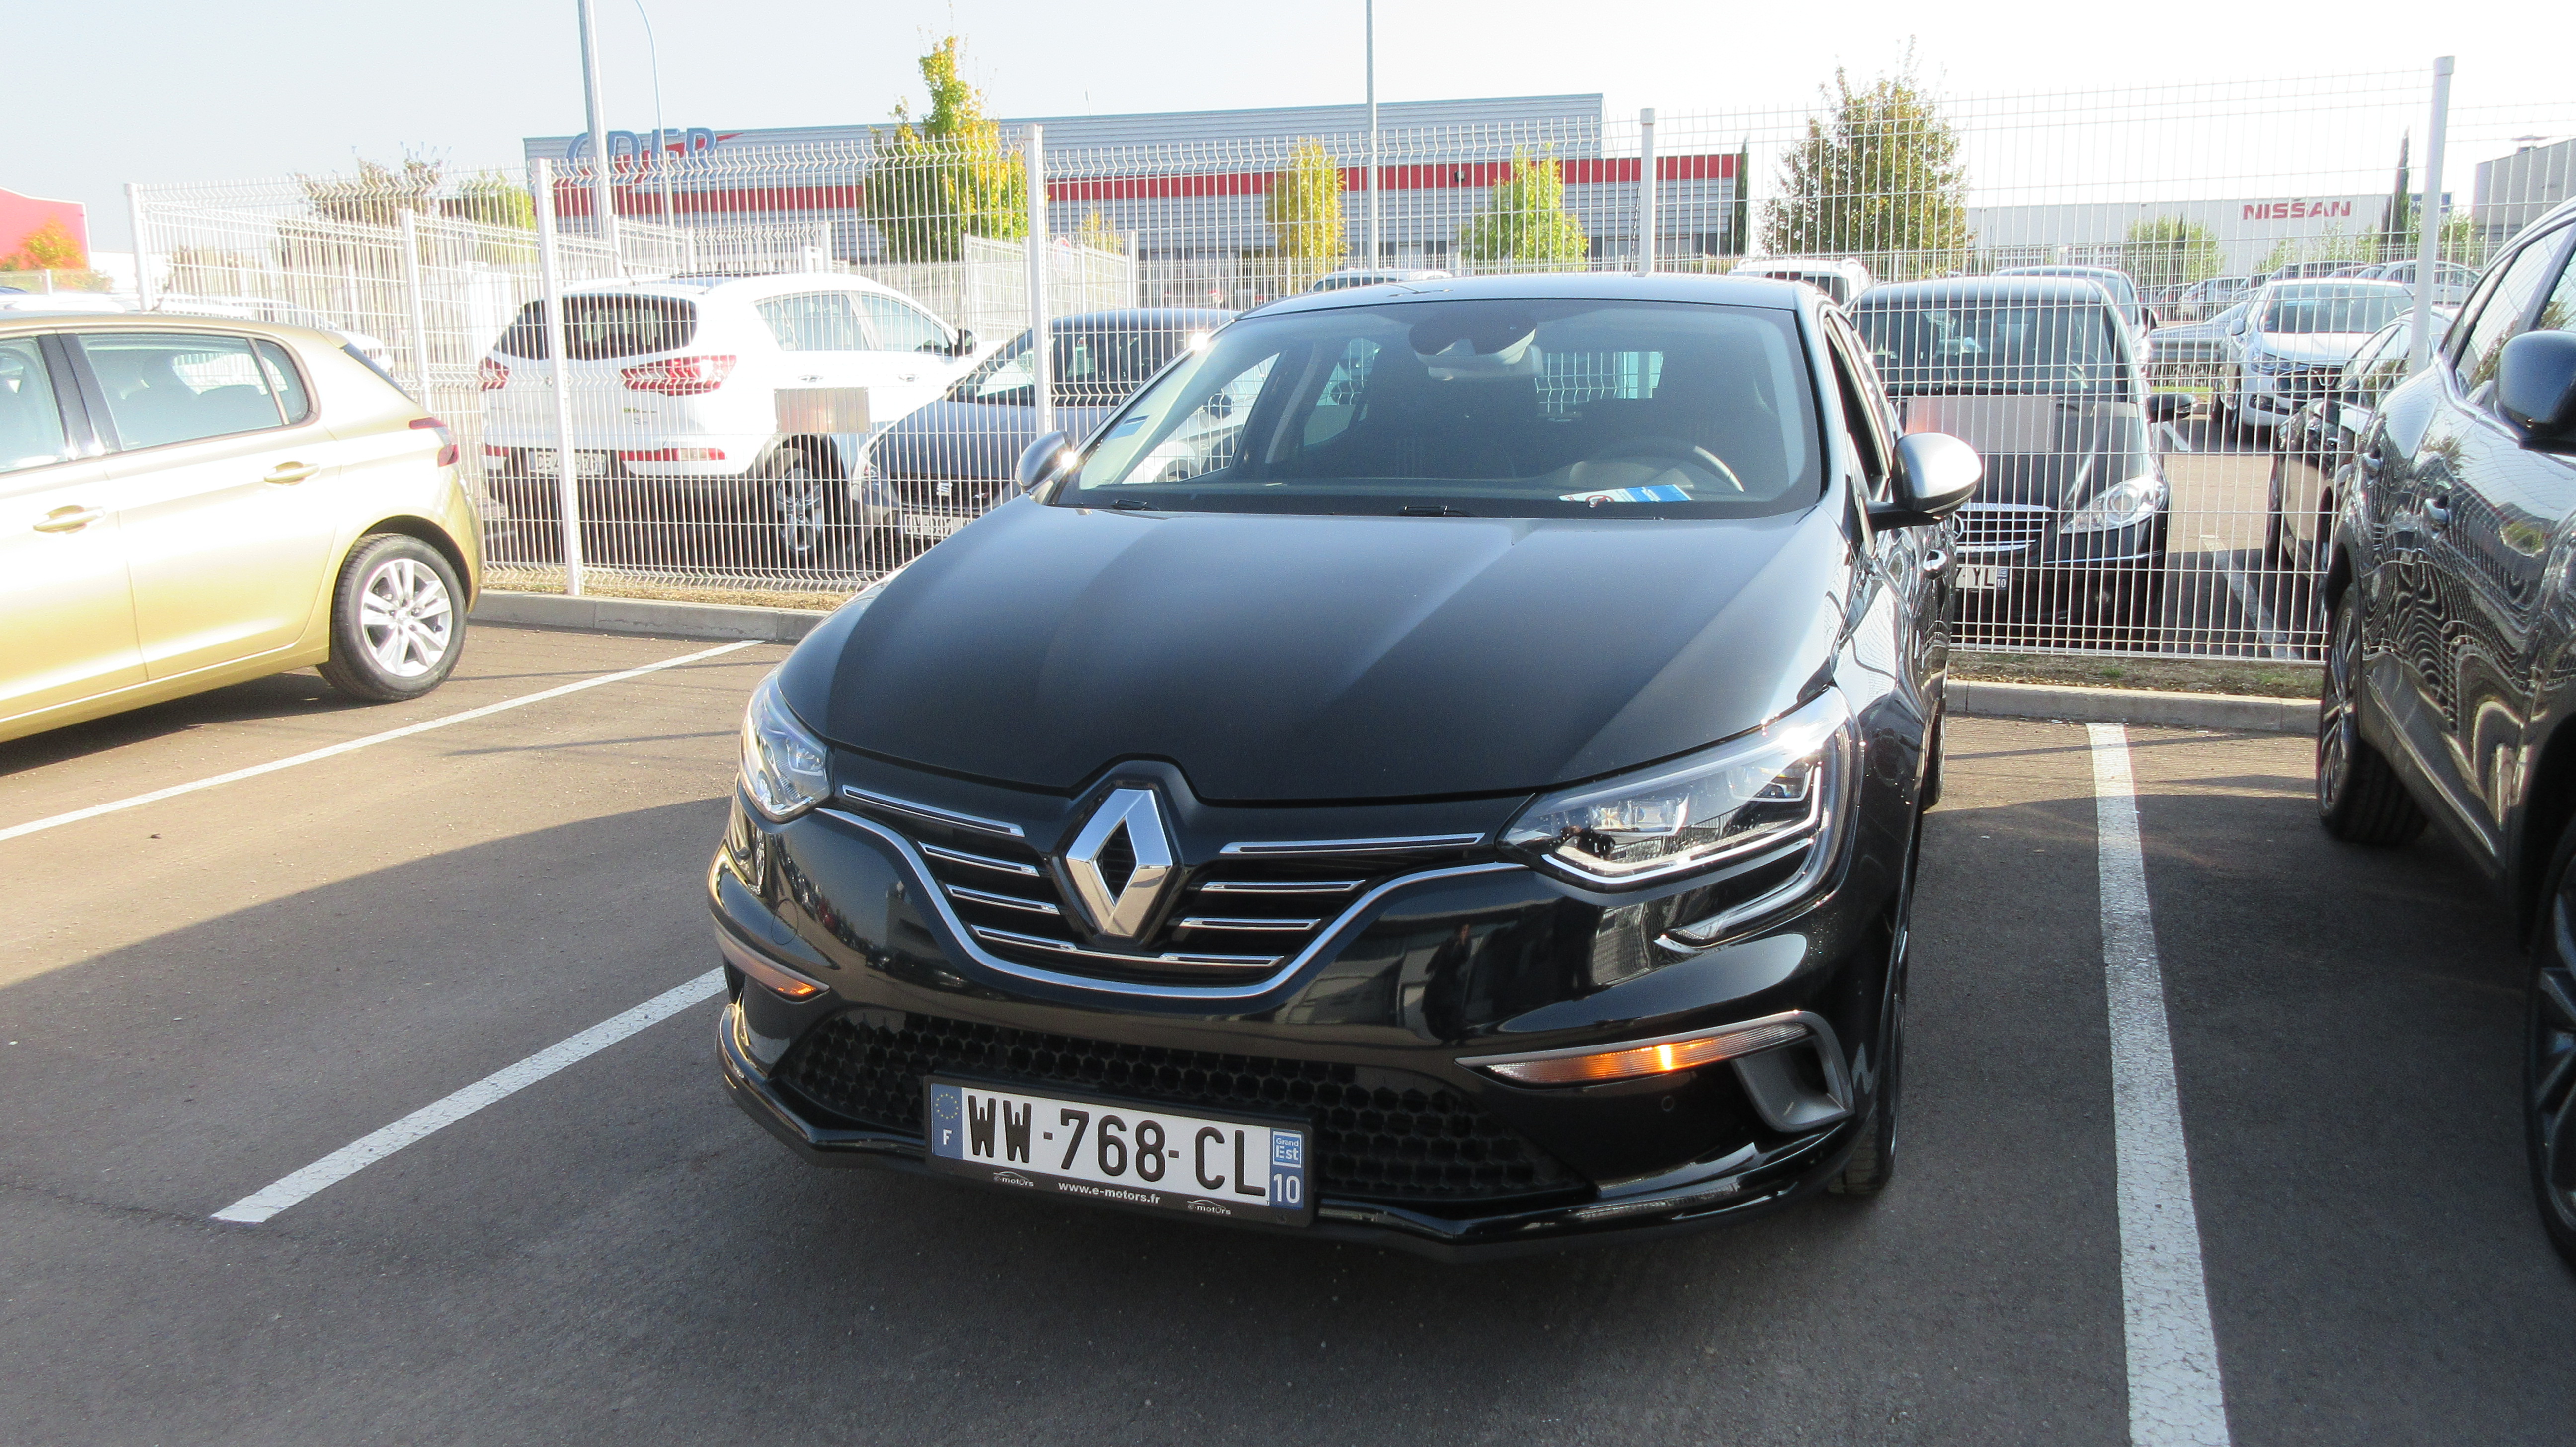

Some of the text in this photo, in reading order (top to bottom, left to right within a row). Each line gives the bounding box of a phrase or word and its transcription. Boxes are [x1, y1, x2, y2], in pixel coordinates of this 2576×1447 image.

[2243, 201, 2351, 220] NISSAN
[1997, 578, 2007, 588] 10
[943, 1129, 953, 1145] F
[968, 1095, 1266, 1196] WW-768-CL
[1276, 1137, 1299, 1147] Grand
[1275, 1145, 1299, 1160] Est
[1058, 1182, 1161, 1204] www.e-motors.fr
[1273, 1173, 1300, 1204] 10
